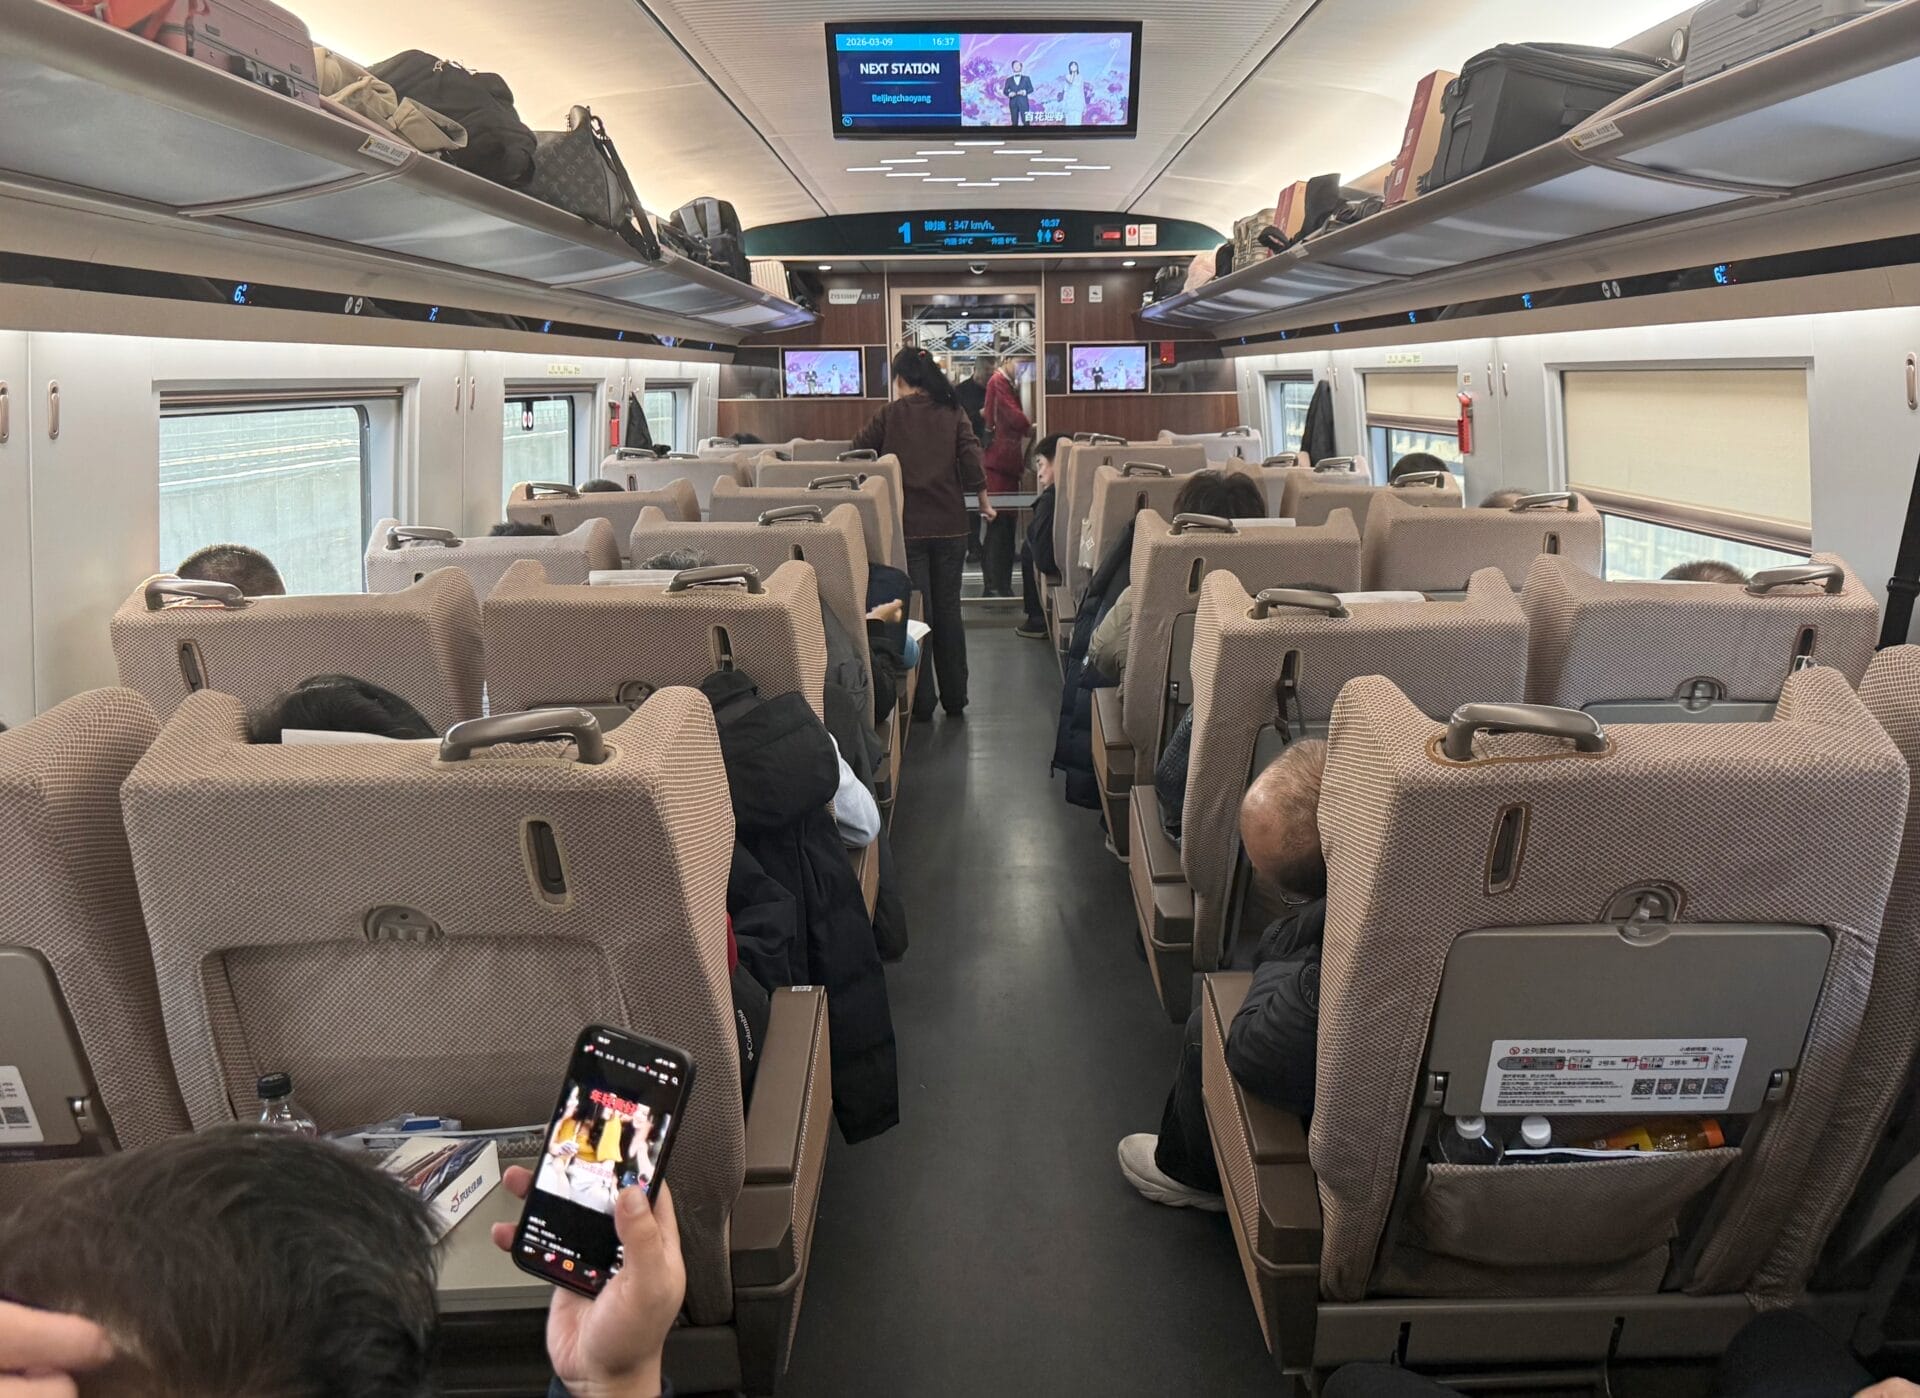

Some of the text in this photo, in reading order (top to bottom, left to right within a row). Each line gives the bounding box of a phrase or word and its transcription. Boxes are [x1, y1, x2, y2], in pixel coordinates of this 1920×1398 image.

[846, 38, 893, 46] 2026-03-09
[932, 38, 955, 46] 16:37
[860, 63, 940, 74] NEXT STATION
[872, 94, 931, 104] Beijingchaoyang
[898, 222, 912, 244] 1
[737, 1009, 753, 1051] Columbia
